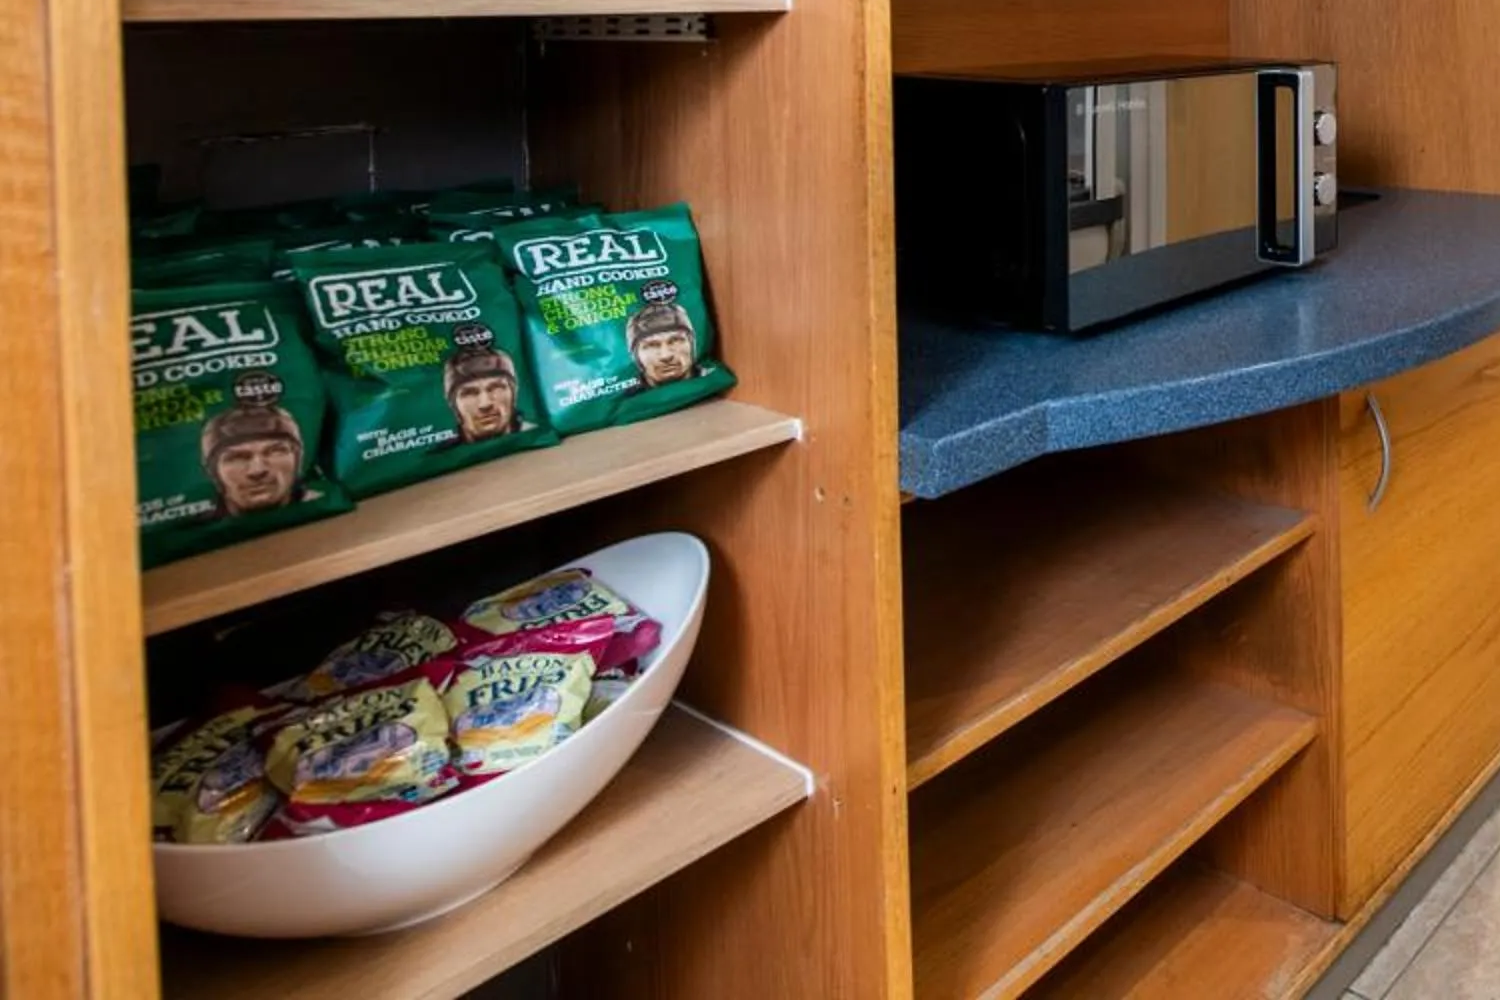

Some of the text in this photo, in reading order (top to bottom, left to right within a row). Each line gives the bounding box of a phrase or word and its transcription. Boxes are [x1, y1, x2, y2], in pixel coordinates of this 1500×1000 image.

[527, 234, 658, 276] REAL
[322, 272, 466, 317] REAL
[536, 265, 670, 297] HAND COOKED
[134, 310, 265, 360] EAL
[332, 307, 481, 339] HAND COOKED
[563, 308, 628, 331] ONION
[342, 326, 428, 349] STRONG
[164, 351, 278, 382] COOKED
[480, 654, 567, 681] BACON
